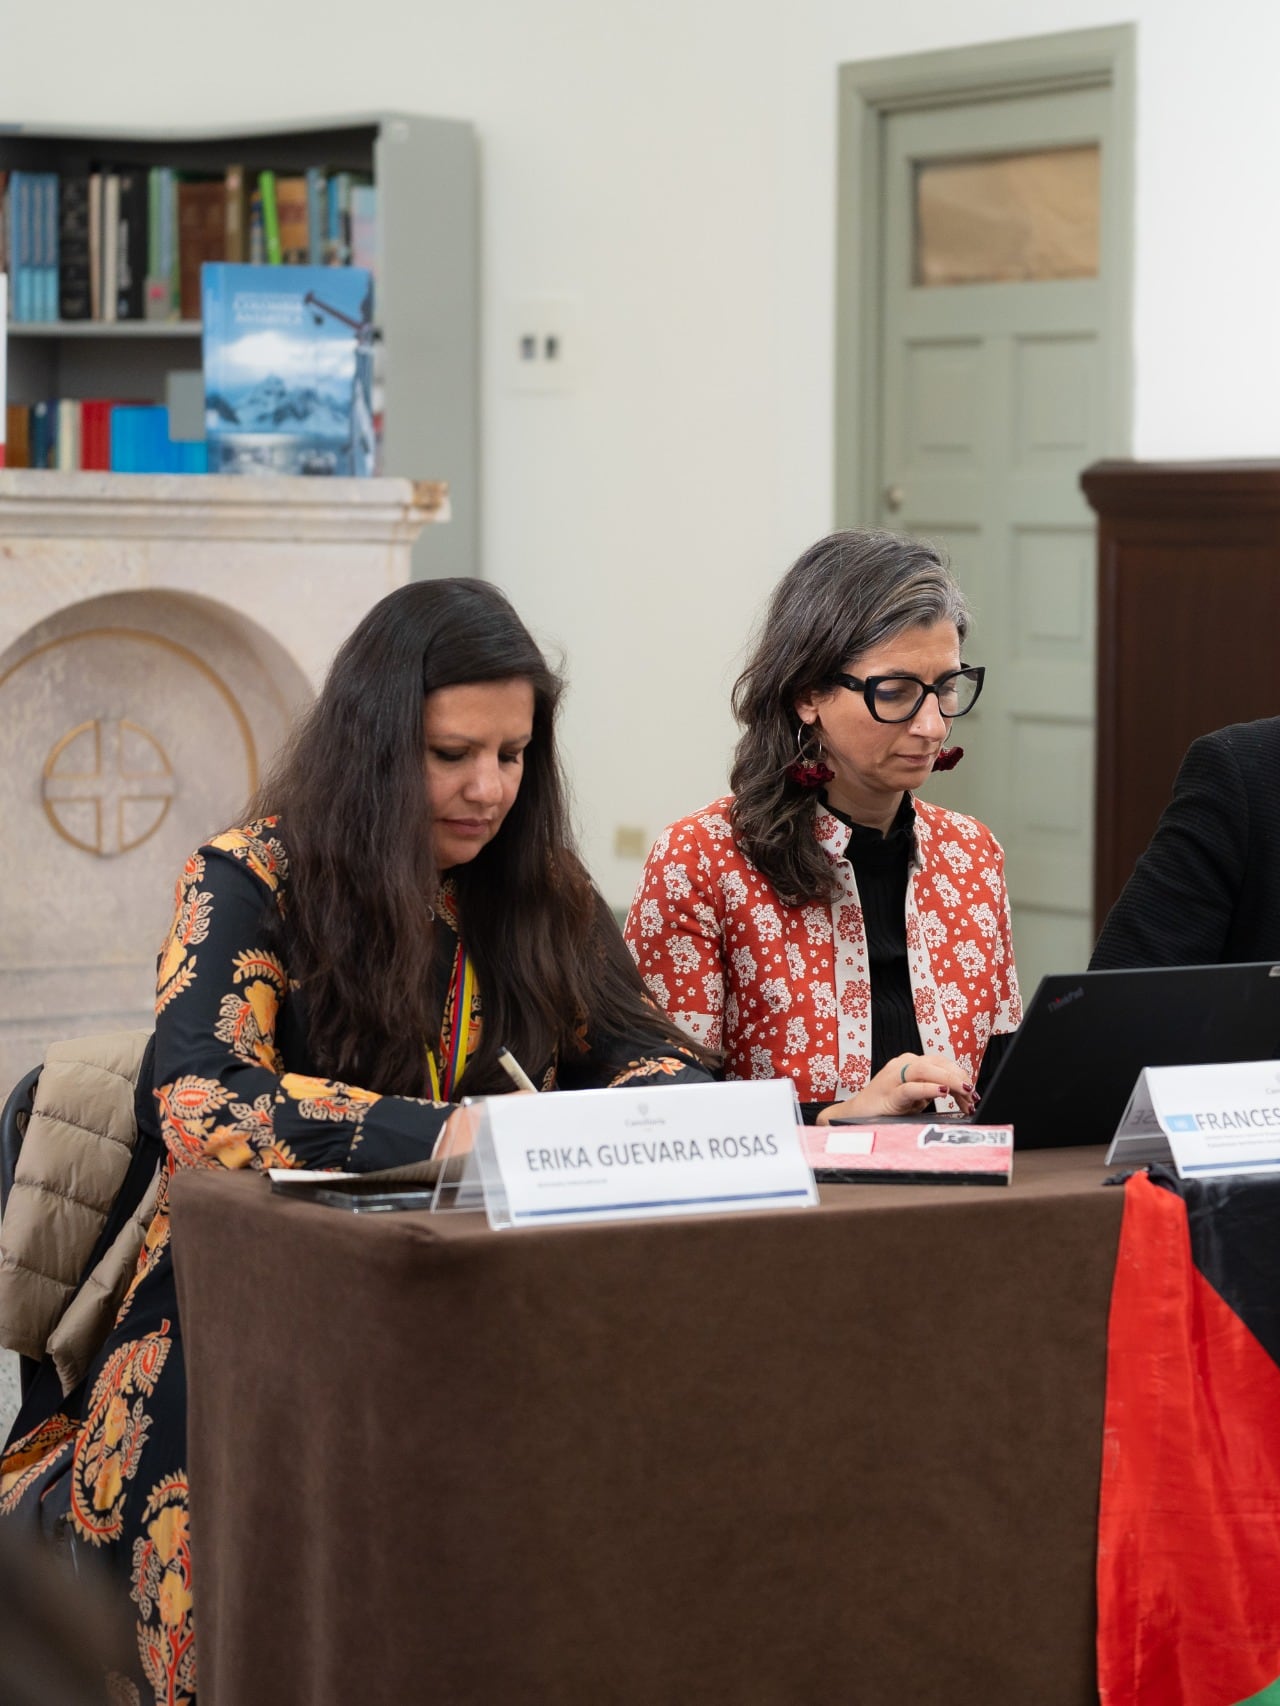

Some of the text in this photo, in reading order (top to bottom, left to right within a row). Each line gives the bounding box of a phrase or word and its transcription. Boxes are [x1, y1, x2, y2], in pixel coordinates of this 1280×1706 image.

[525, 1134, 779, 1172] ERIKA GUEVARA ROSAS
